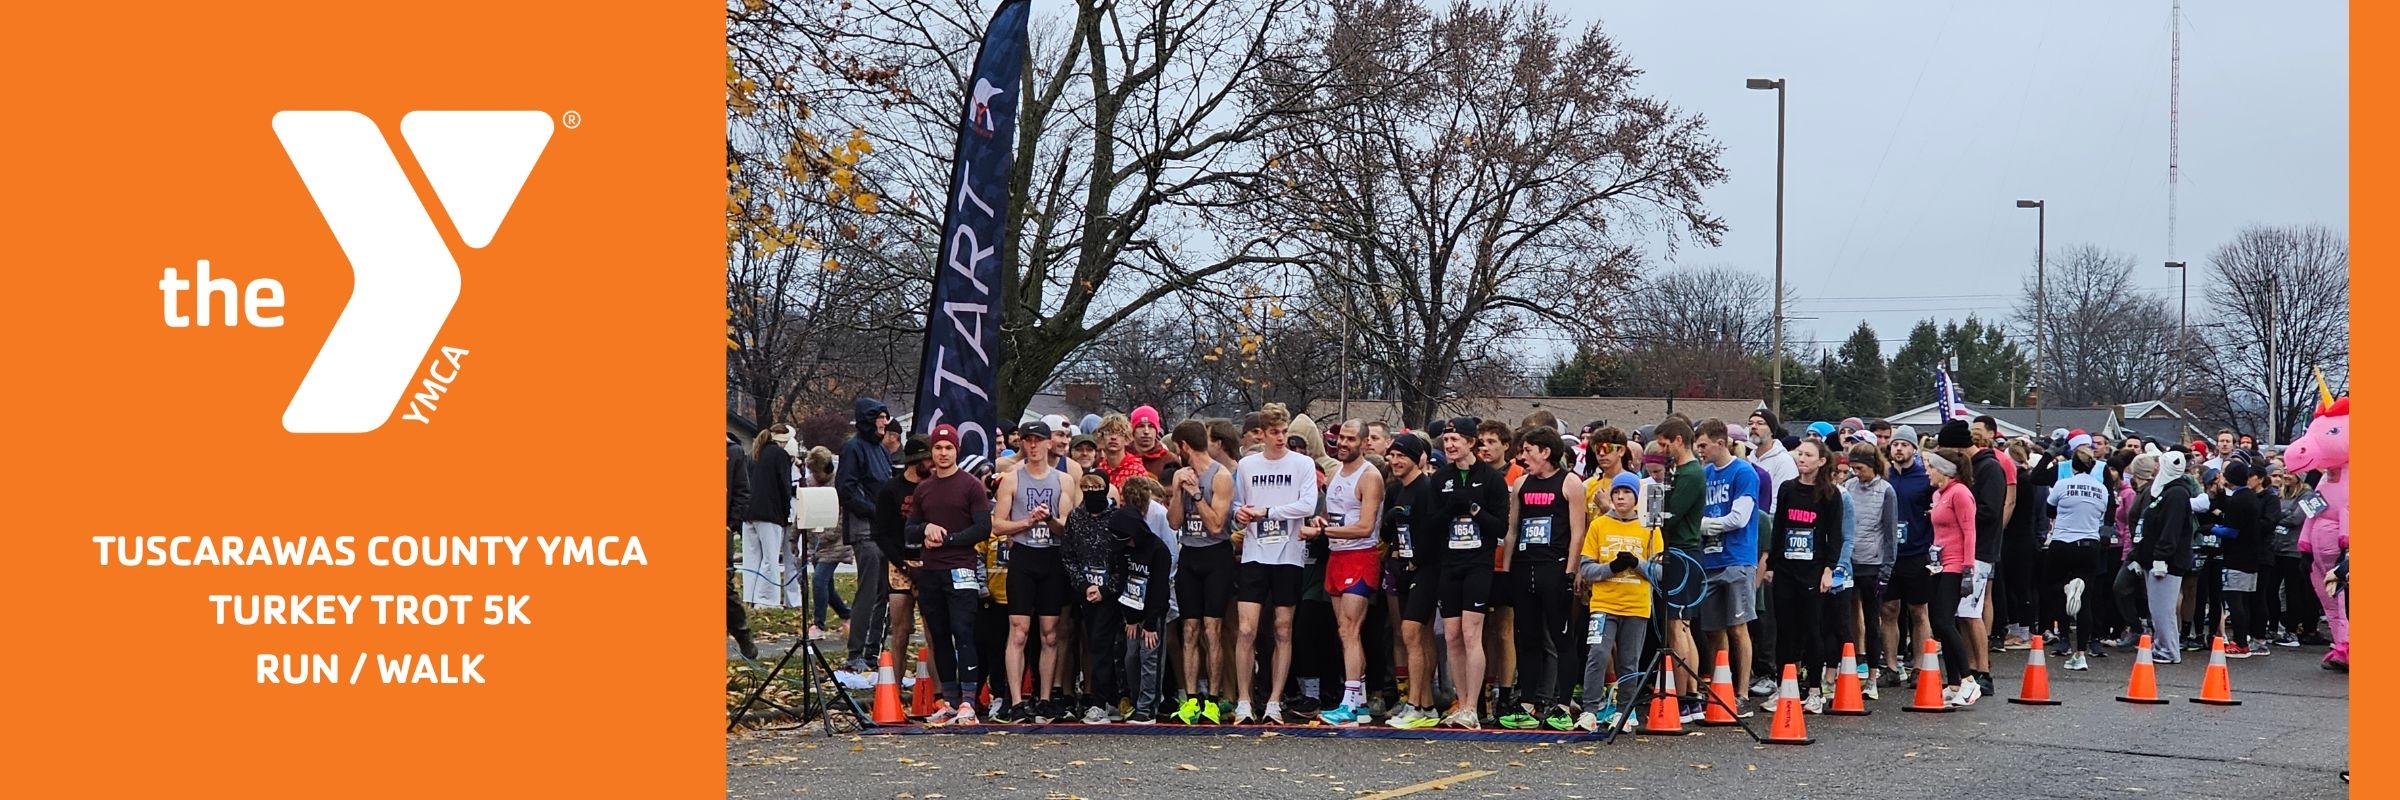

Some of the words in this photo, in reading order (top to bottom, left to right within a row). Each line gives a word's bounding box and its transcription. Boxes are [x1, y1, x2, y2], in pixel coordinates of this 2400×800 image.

[1252, 474, 1292, 487] AKRON
[1705, 483, 1730, 506] IONS
[1187, 520, 1203, 531] 1437
[1263, 520, 1280, 531] 984
[1453, 524, 1474, 536] 1654
[1031, 527, 1050, 538] 1474
[1525, 526, 1545, 538] 1504
[1789, 536, 1808, 548] 1708
[1085, 574, 1104, 586] 1343
